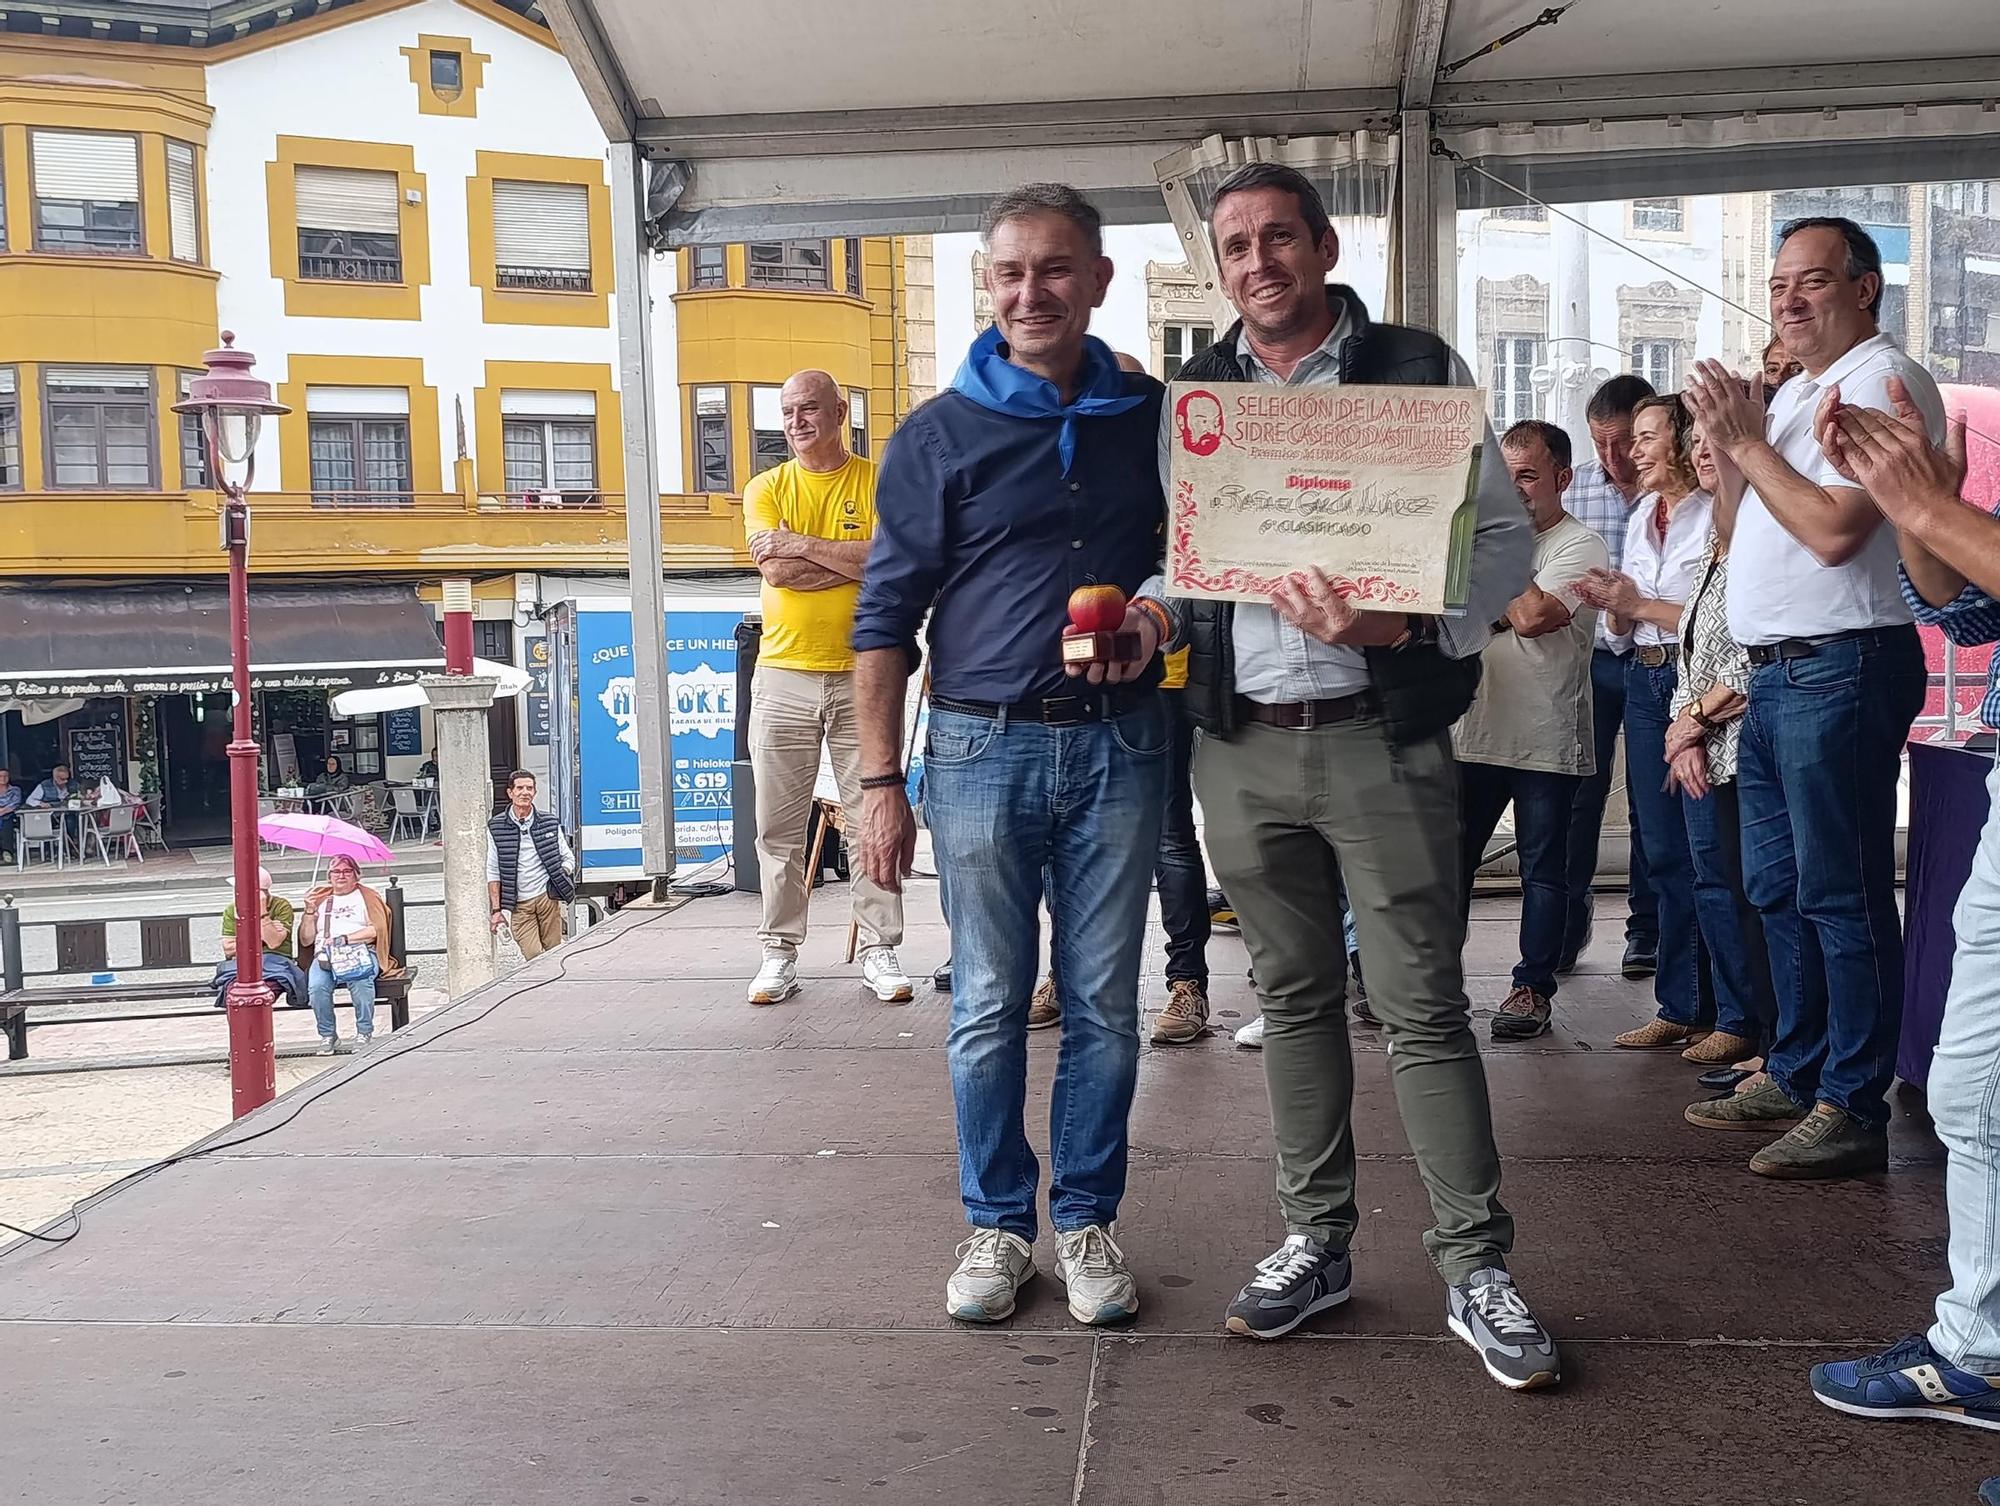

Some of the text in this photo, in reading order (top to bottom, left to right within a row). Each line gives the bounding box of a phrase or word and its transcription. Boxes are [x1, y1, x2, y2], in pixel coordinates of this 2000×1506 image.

[1335, 398, 1365, 421] DE
[1367, 398, 1395, 421] LA
[1398, 398, 1471, 424] MEYOR
[1235, 421, 1286, 444] SIDRE
[1285, 475, 1352, 490] Diploma
[688, 639, 707, 650] UN
[694, 772, 728, 788] 619
